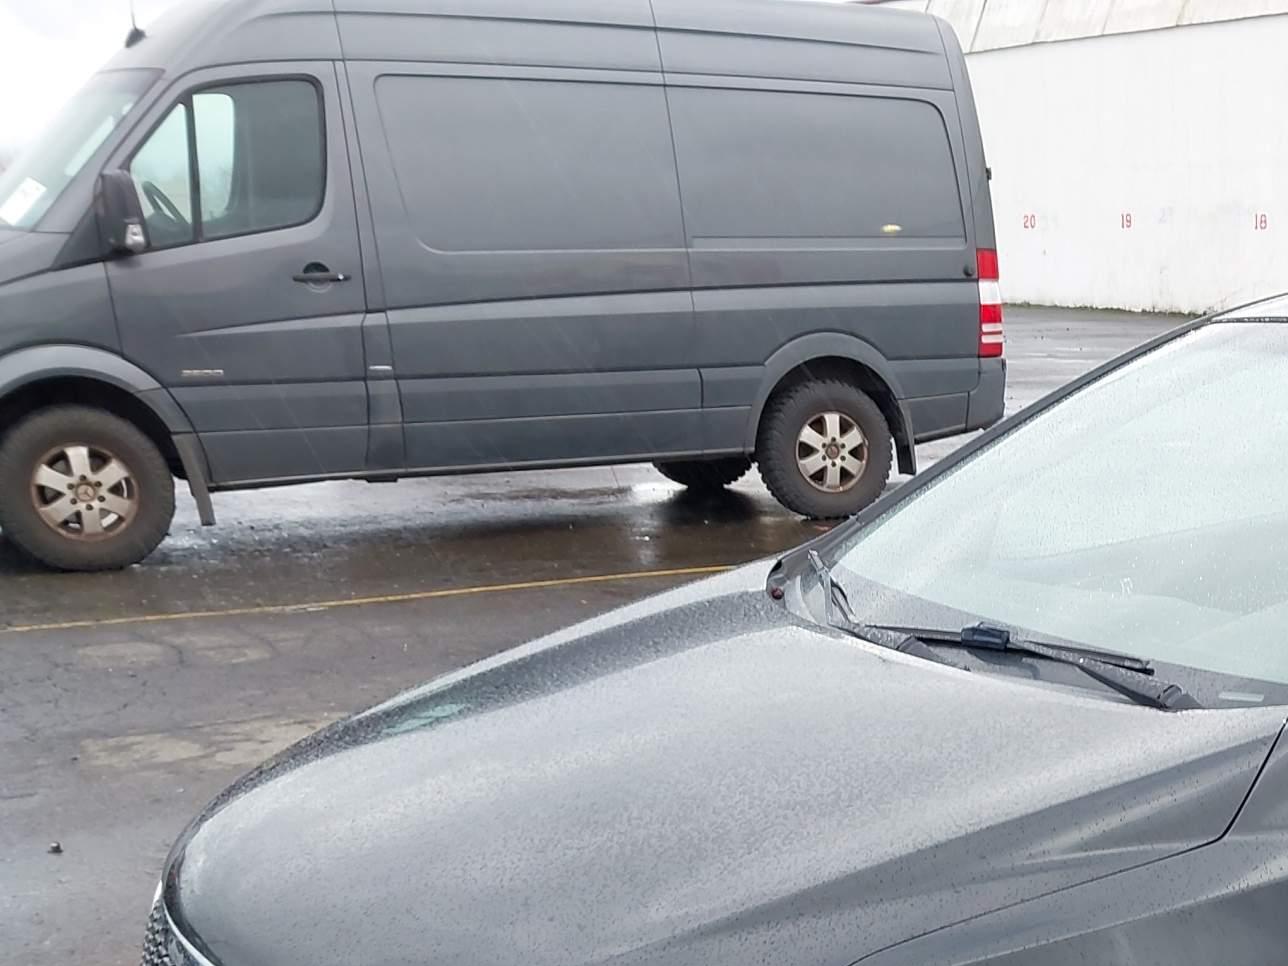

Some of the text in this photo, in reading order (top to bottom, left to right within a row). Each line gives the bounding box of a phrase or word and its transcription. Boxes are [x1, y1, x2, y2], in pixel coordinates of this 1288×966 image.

[1023, 213, 1037, 230] 20
[1120, 212, 1134, 230] 19
[1254, 213, 1268, 230] 18
